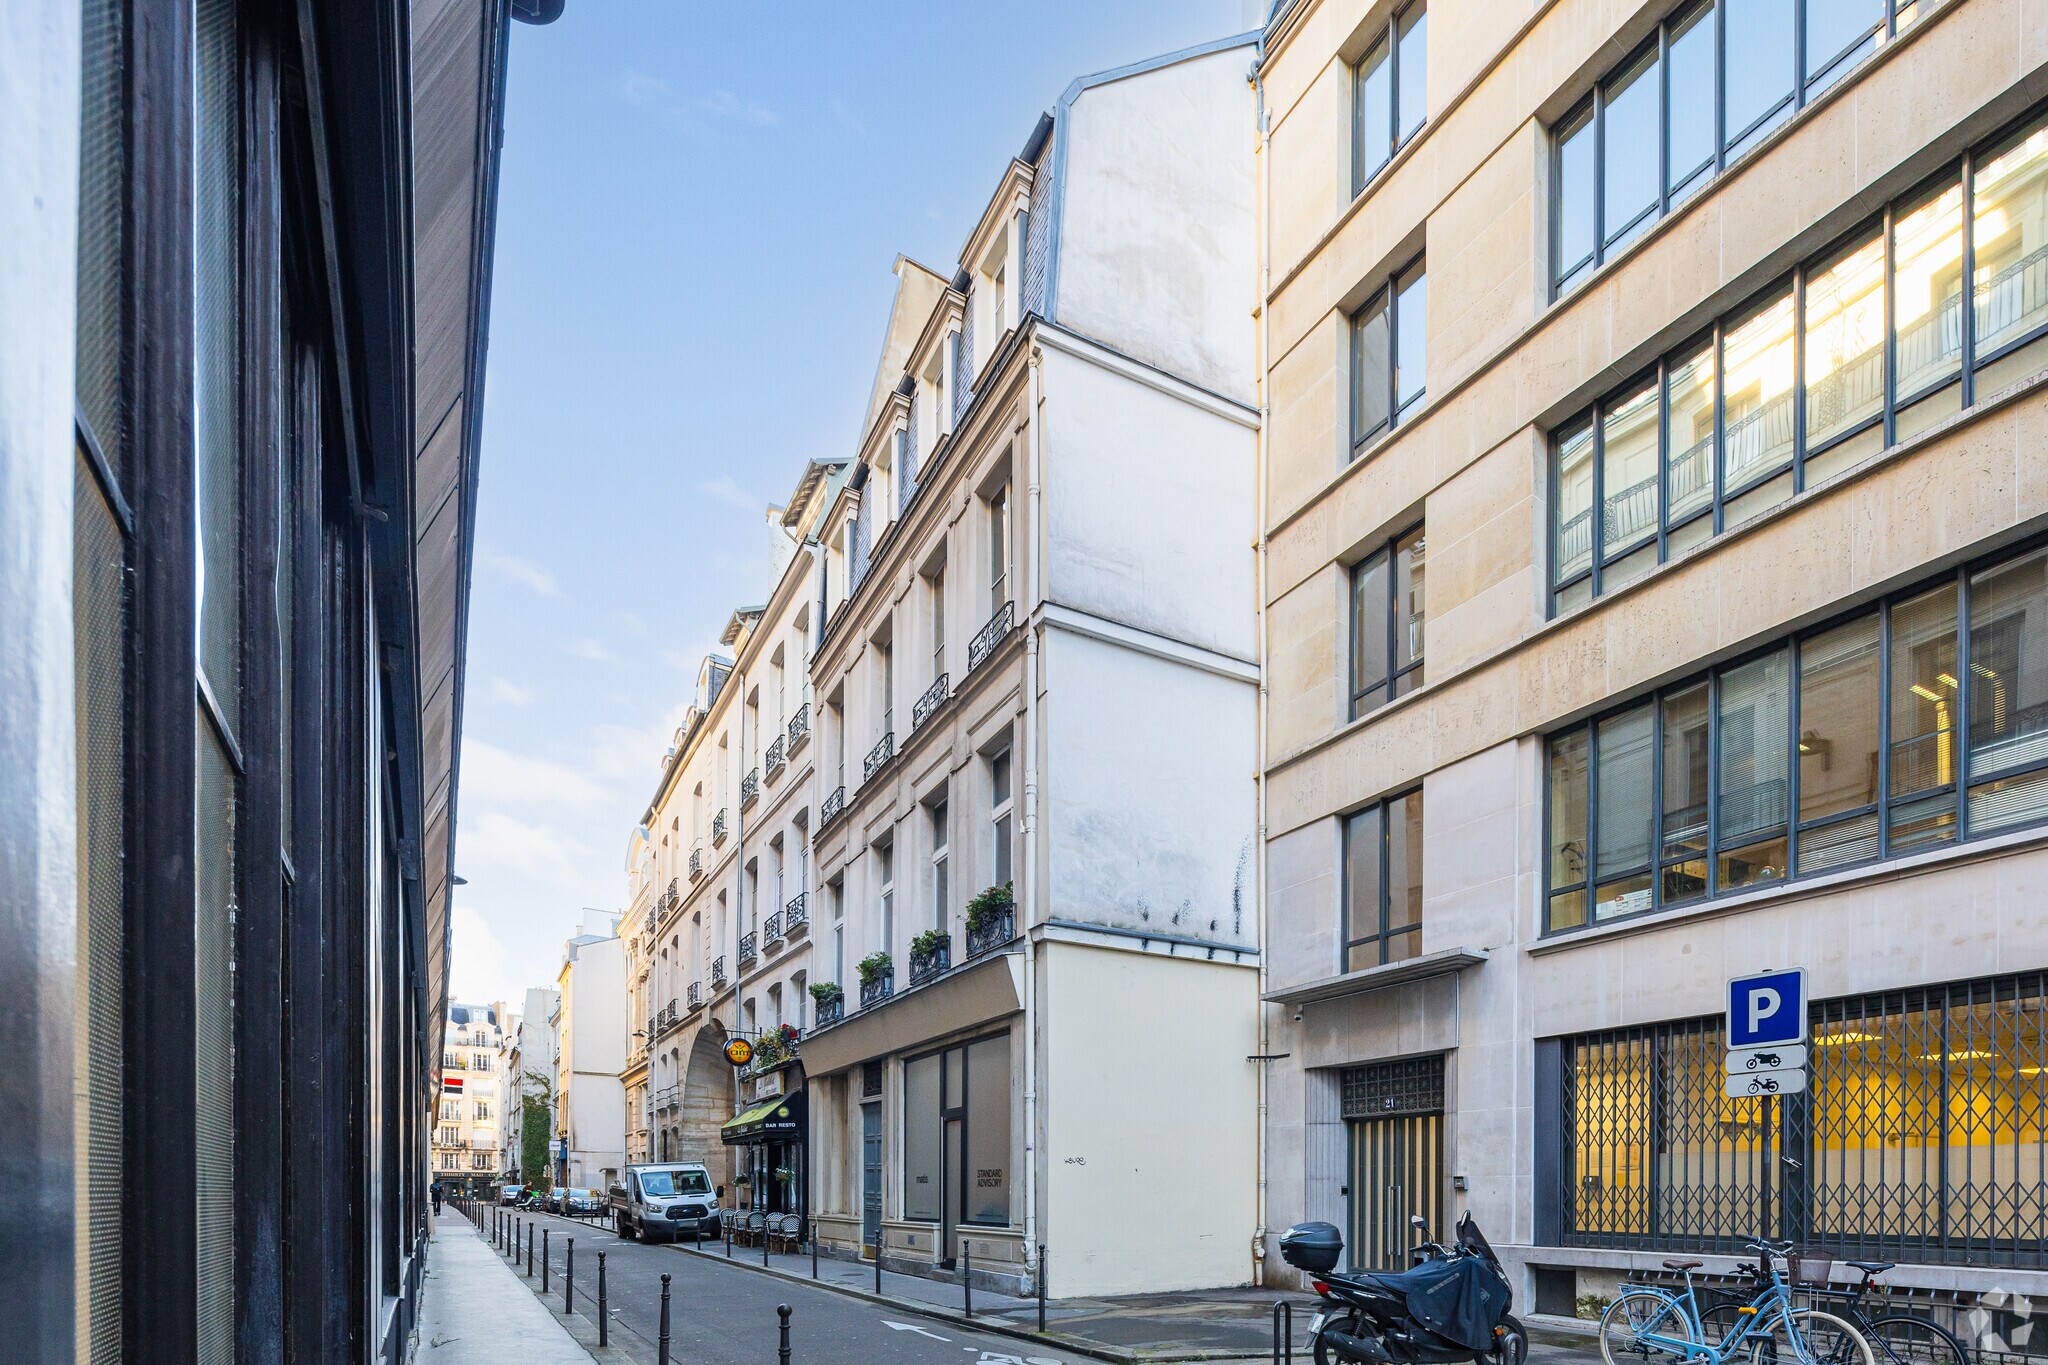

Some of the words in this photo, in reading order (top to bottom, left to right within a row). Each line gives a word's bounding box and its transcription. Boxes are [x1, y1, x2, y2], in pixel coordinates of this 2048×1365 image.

[1748, 987, 1781, 1034] P
[1385, 1098, 1394, 1108] 21
[977, 1169, 1002, 1178] STANDARD
[977, 1179, 1002, 1187] ADVISORY
